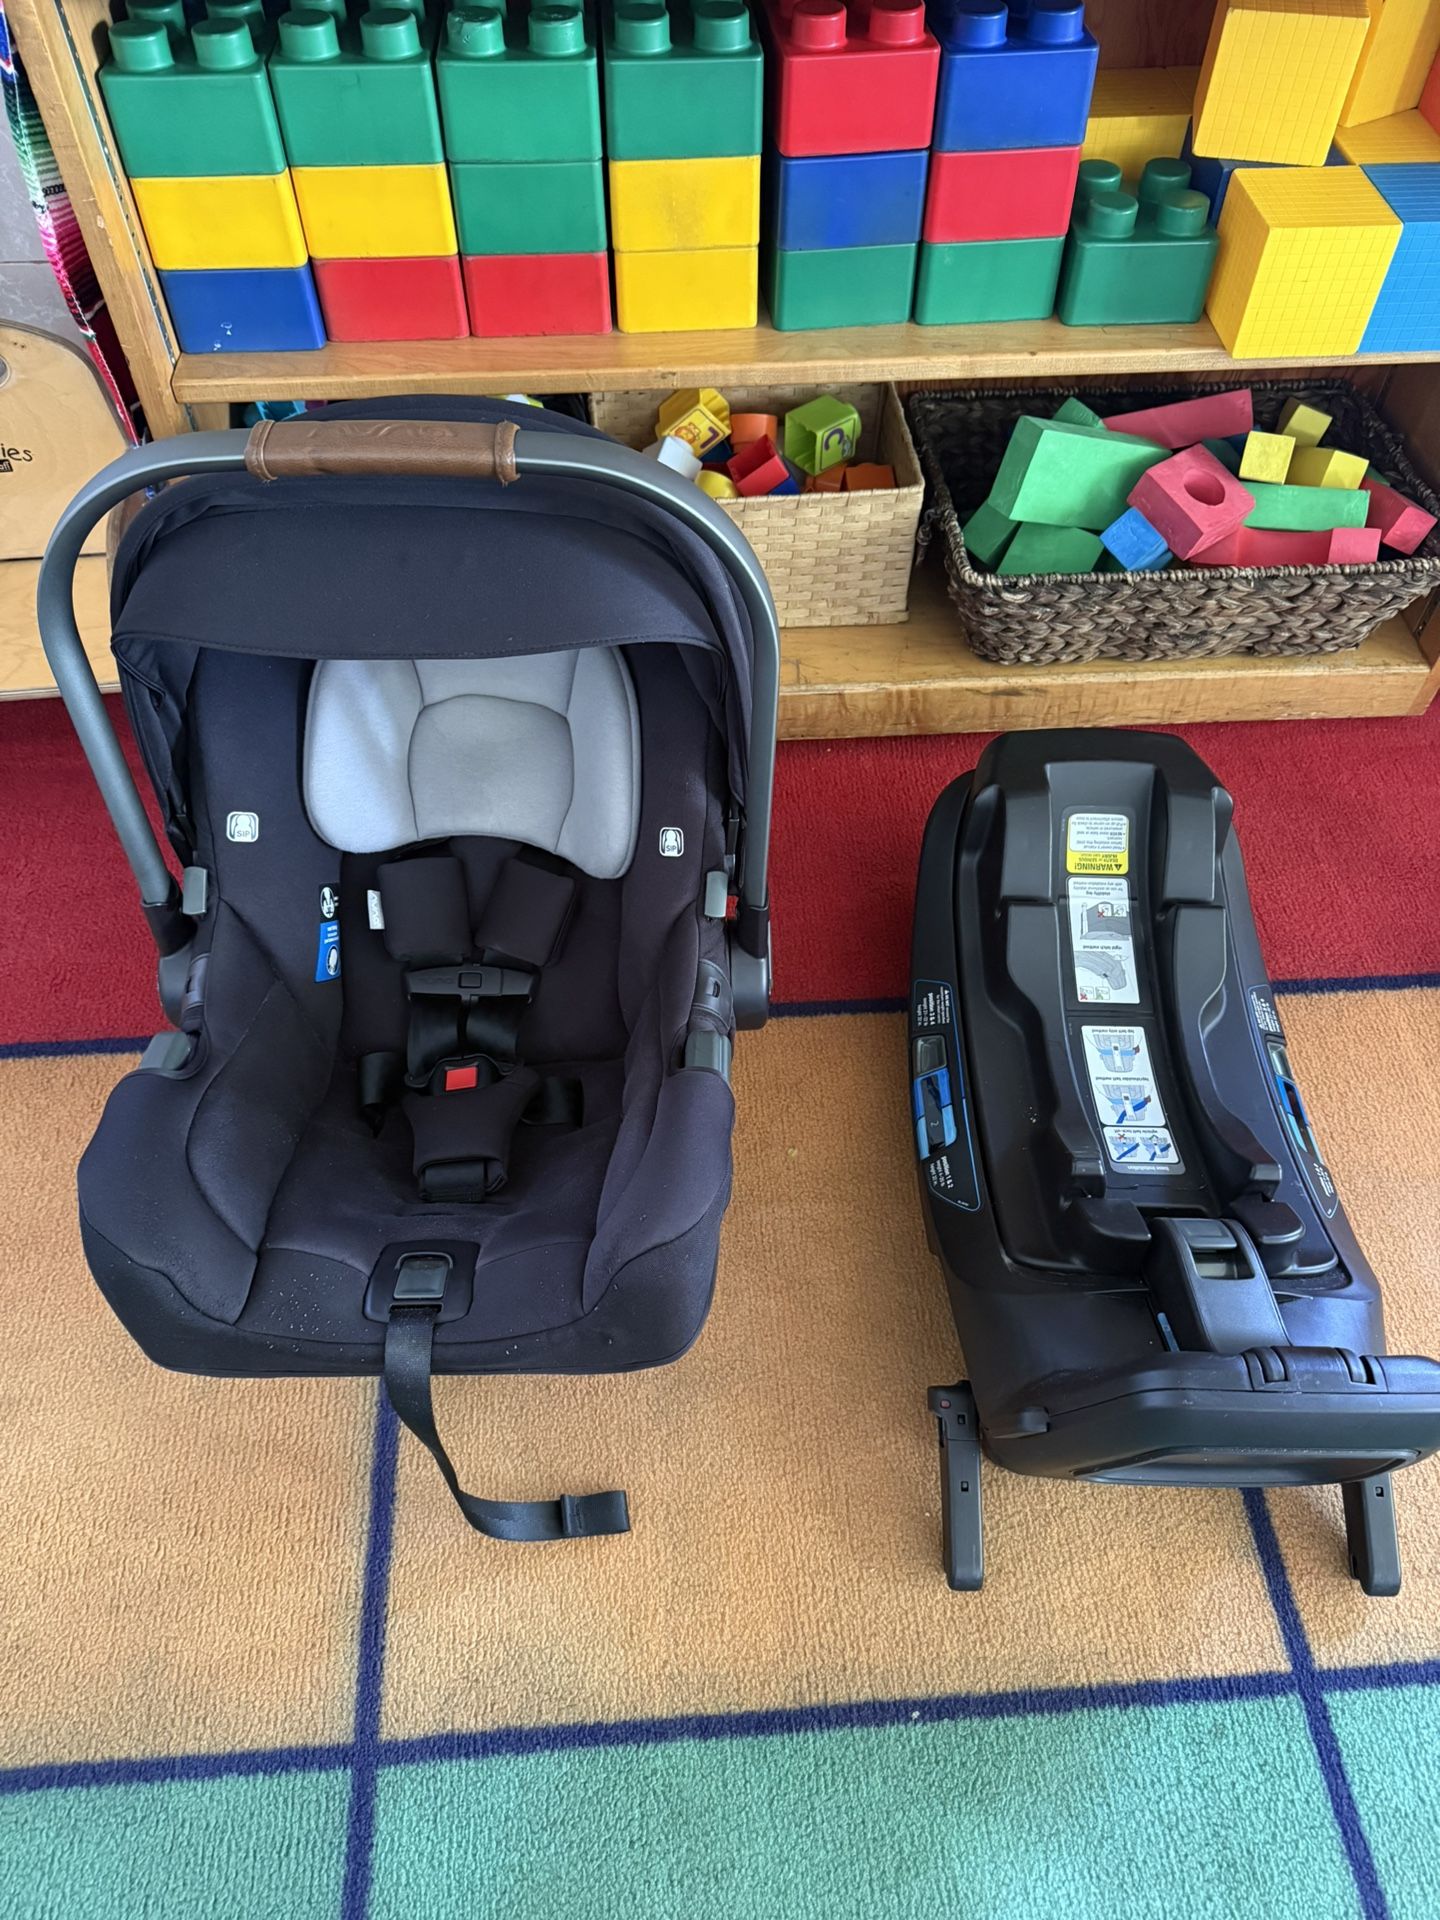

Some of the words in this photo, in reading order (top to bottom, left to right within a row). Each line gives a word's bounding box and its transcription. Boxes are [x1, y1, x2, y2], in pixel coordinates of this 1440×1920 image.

[824, 427, 845, 451] C
[236, 830, 250, 838] SIP
[1074, 863, 1113, 871] WARNING!
[941, 1156, 950, 1176] position
